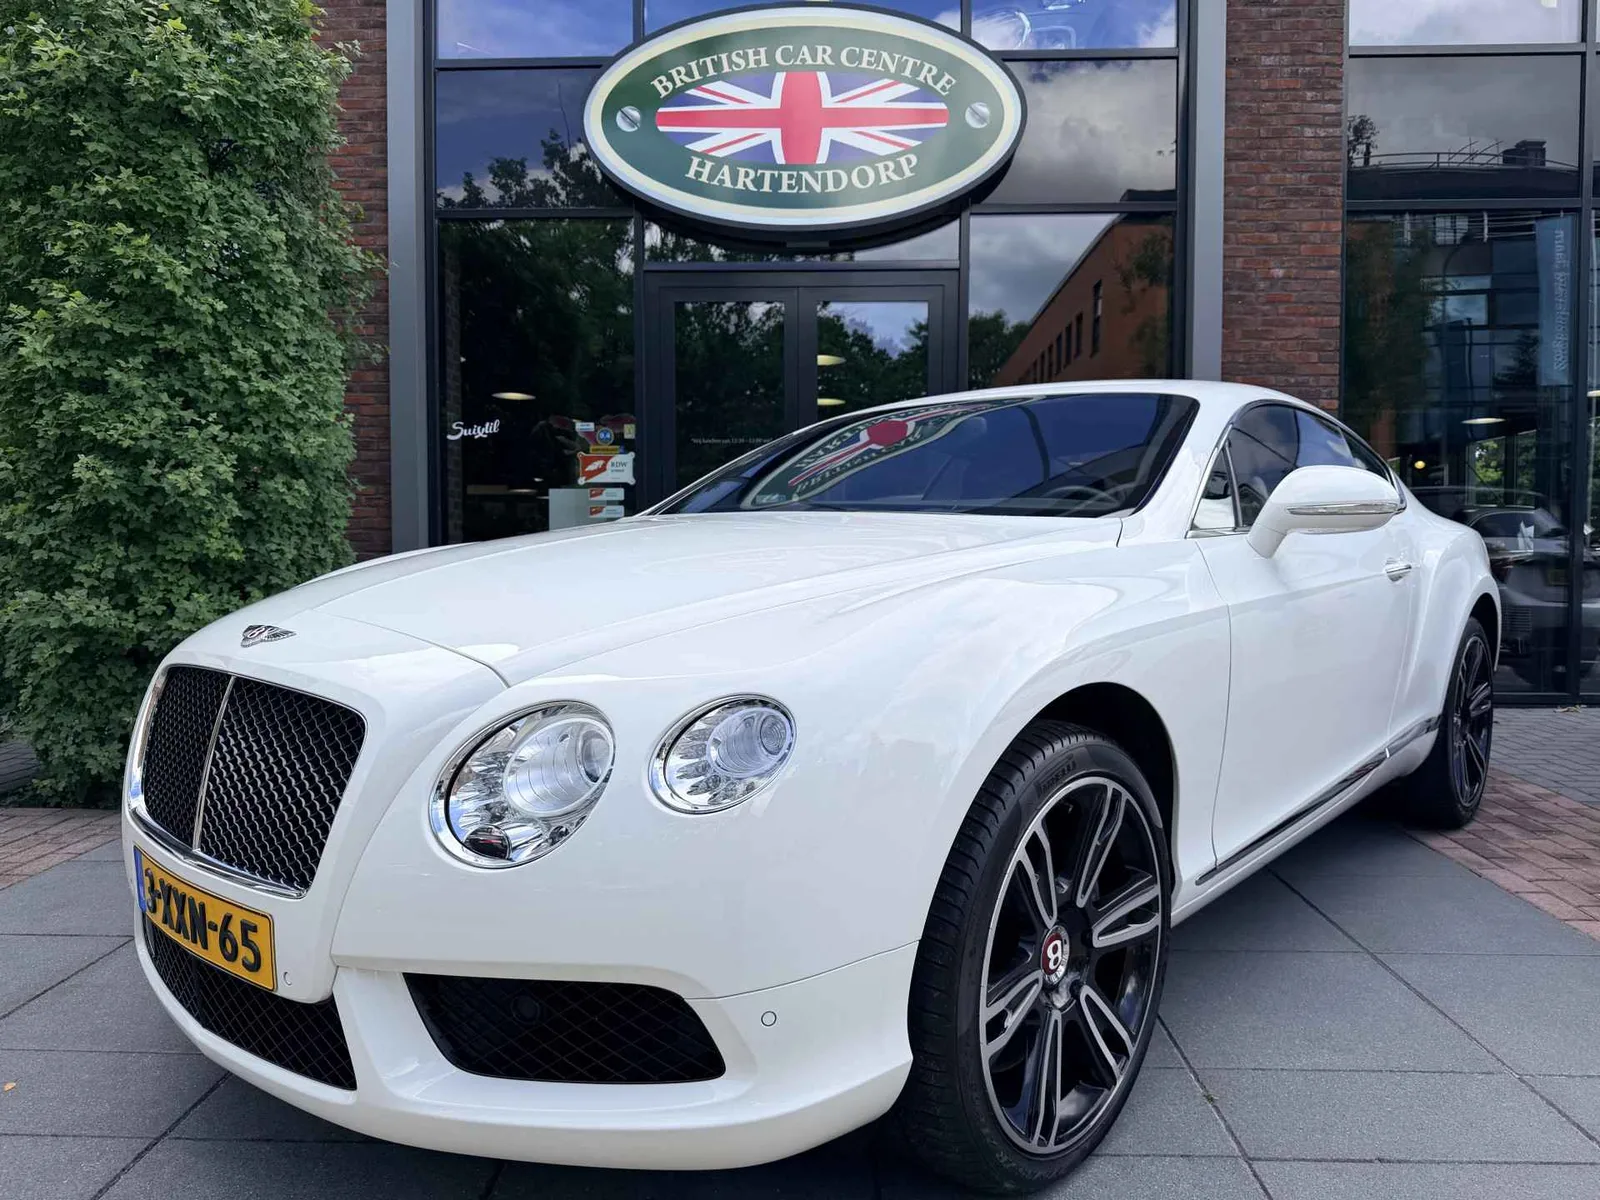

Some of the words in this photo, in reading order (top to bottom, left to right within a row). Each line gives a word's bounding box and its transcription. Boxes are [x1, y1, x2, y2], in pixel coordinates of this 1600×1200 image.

[650, 47, 770, 99] BRITISH
[775, 45, 835, 66] CAR
[840, 46, 957, 96] CENTRE
[685, 152, 919, 194] HARTENDORP
[144, 867, 262, 973] 3-XXN-65
